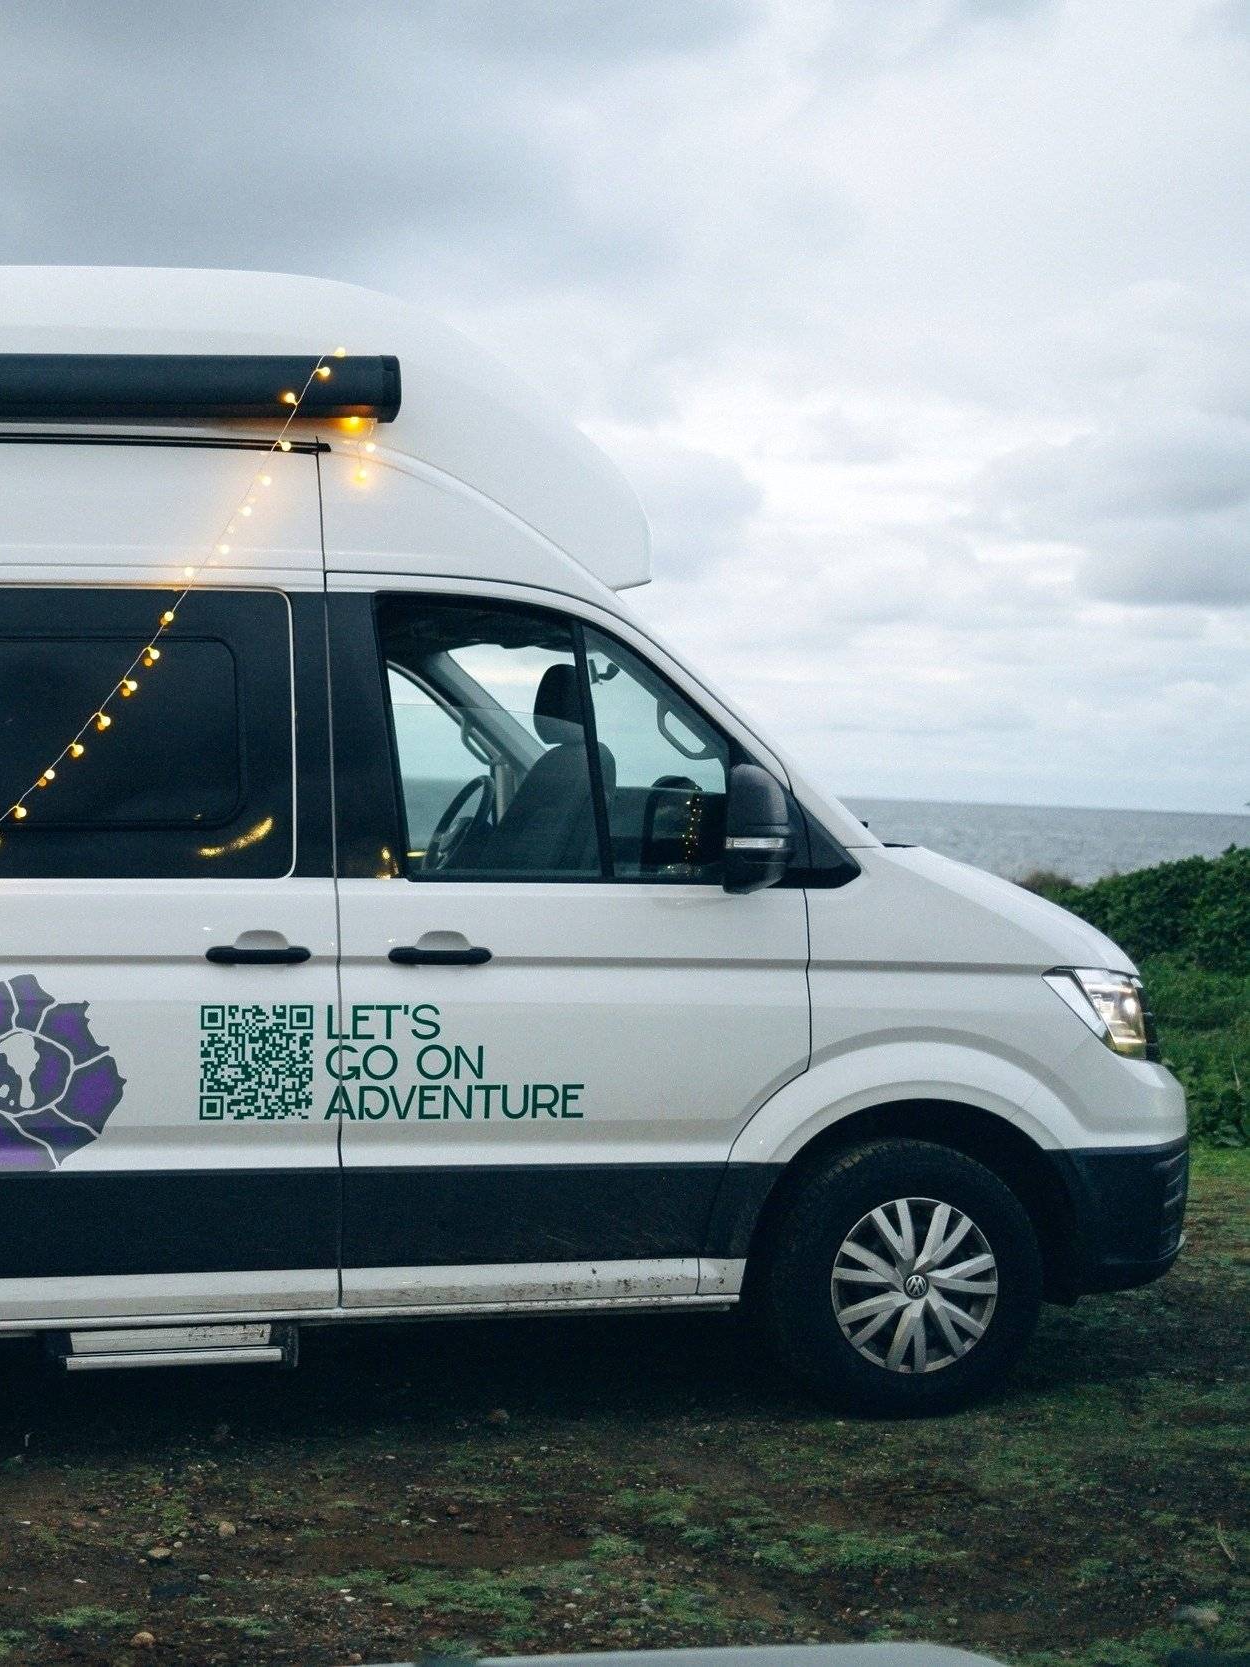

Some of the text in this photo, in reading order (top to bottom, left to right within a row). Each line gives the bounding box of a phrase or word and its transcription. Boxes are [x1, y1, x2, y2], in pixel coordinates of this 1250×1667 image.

[326, 1003, 441, 1040] LET'S
[325, 1043, 484, 1081] GO ON
[323, 1083, 585, 1121] ADVENTURE
